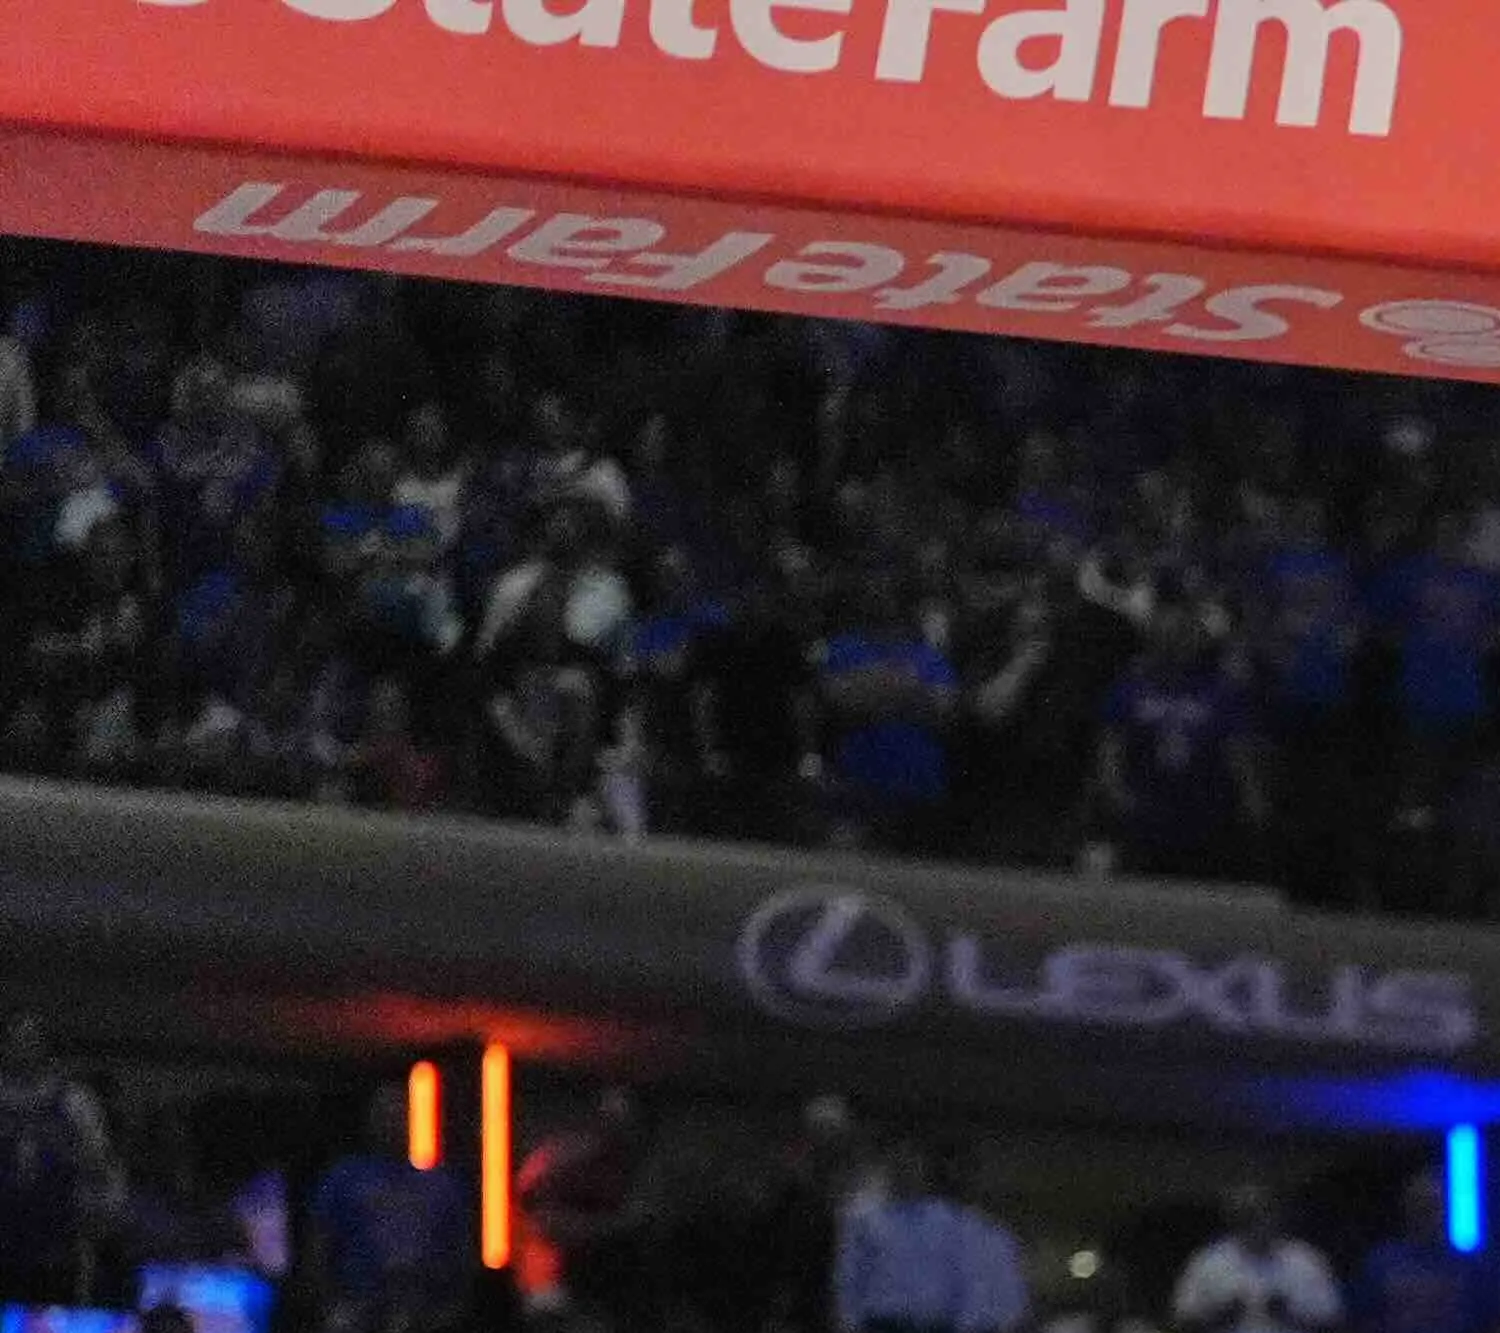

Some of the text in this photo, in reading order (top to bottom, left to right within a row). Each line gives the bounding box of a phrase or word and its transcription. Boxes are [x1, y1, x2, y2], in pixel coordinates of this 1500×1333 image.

[192, 180, 1344, 342] State Farm
[947, 935, 1474, 1049] LEXUS
